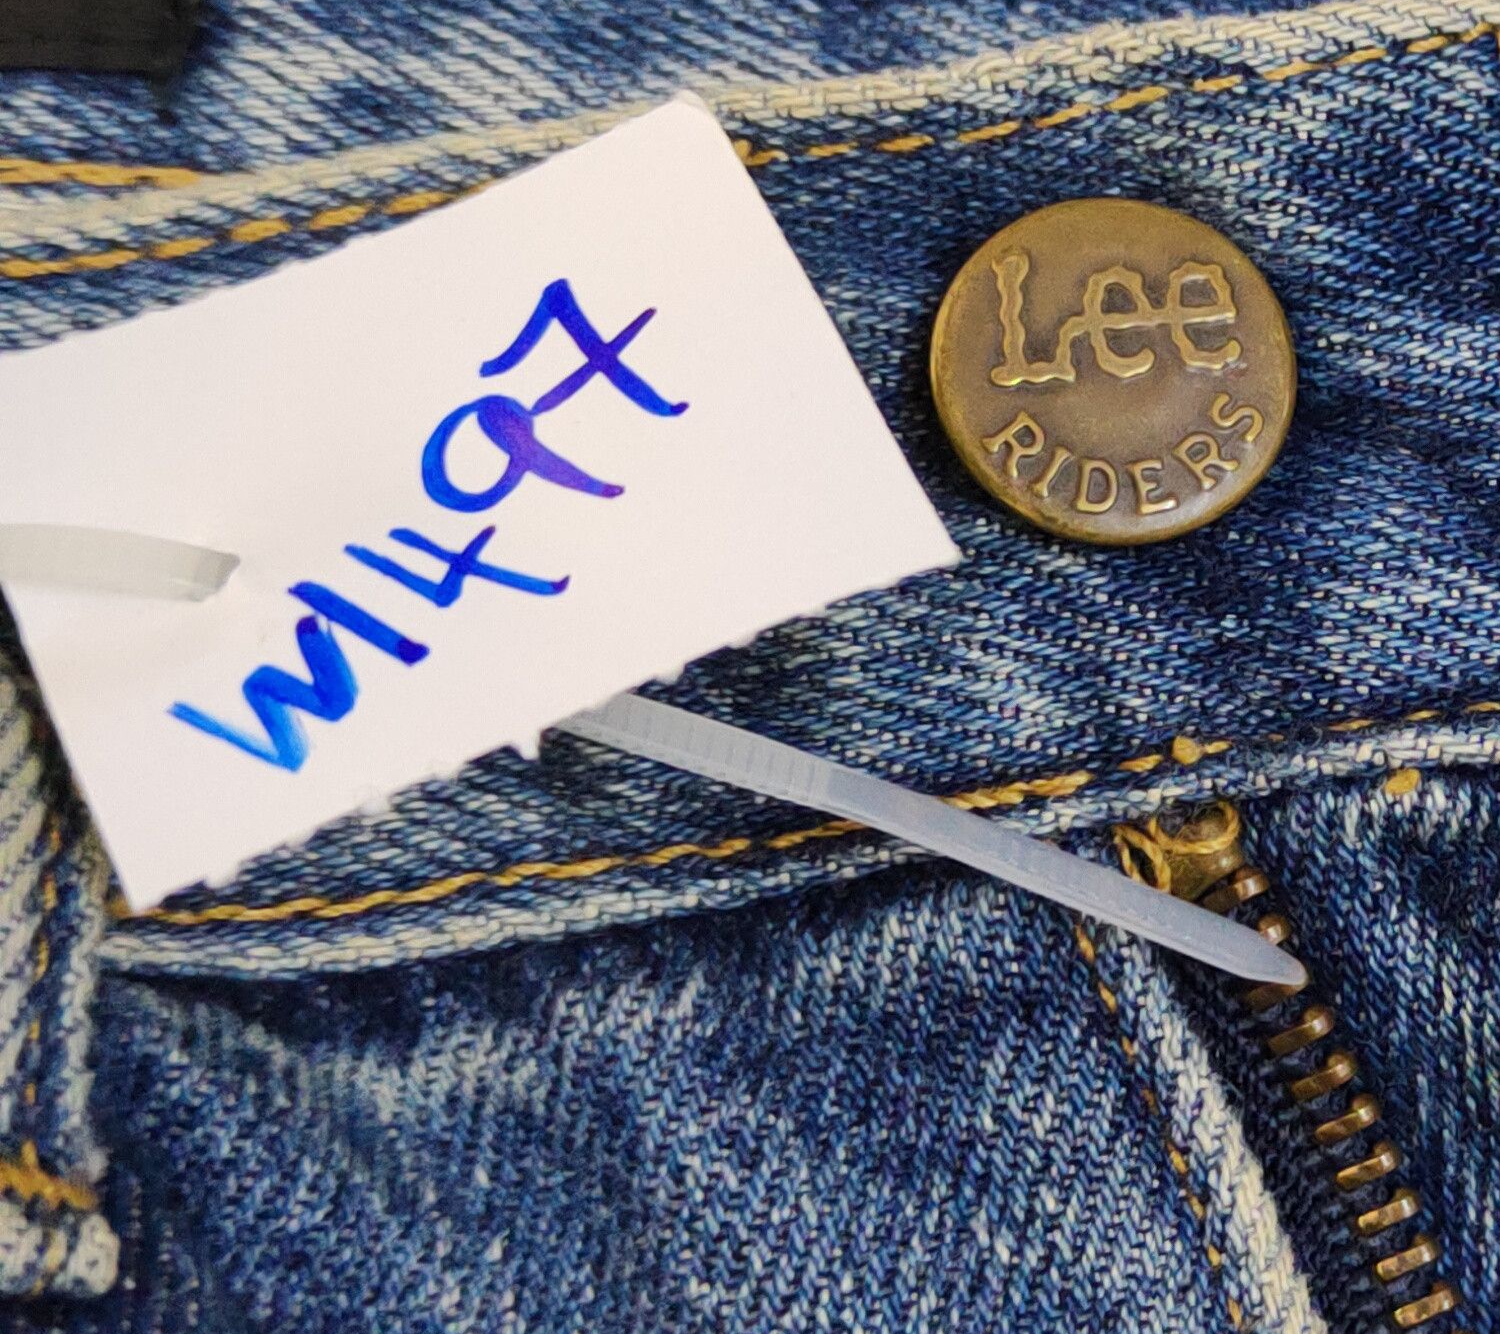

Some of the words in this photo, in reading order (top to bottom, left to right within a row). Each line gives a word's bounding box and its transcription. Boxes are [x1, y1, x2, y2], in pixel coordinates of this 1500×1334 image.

[990, 252, 1242, 388] Lee
[982, 391, 1265, 515] RIDERS
[166, 278, 690, 773] W1497
